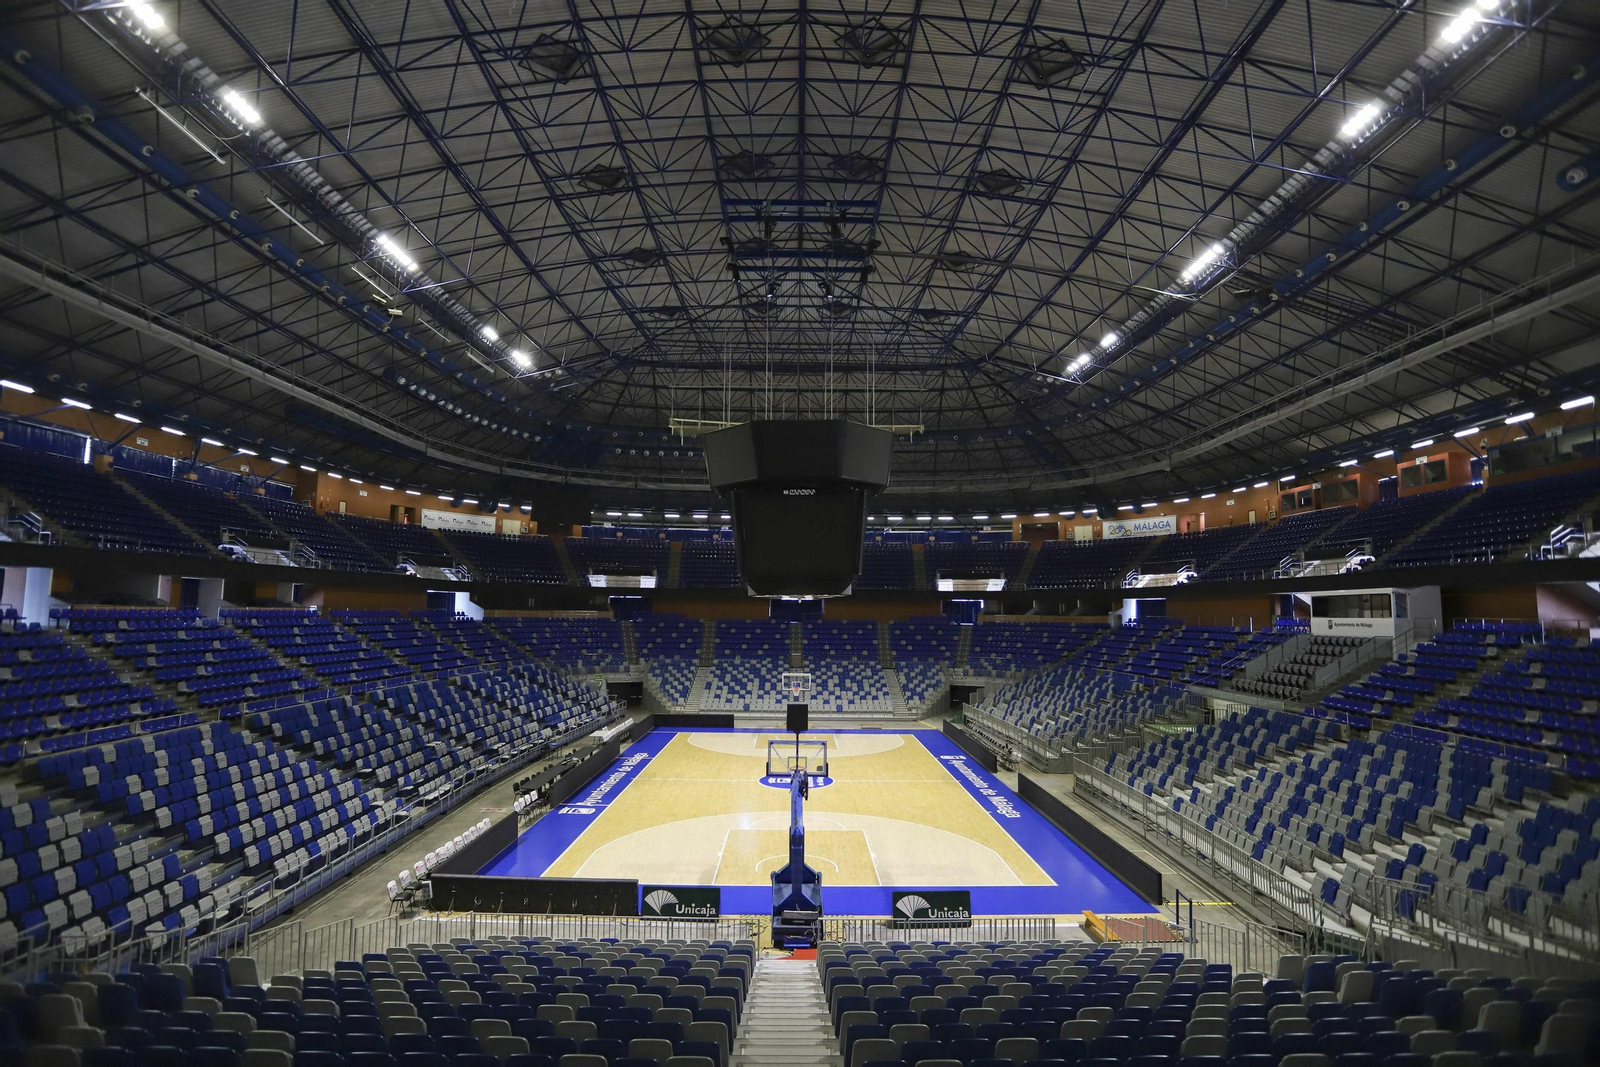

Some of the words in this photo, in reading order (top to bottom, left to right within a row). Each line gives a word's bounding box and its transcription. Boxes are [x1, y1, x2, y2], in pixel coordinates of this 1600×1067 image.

[1133, 520, 1172, 531] MÁLAGA
[675, 903, 717, 917] Unicaja
[928, 906, 970, 919] Unicaja
